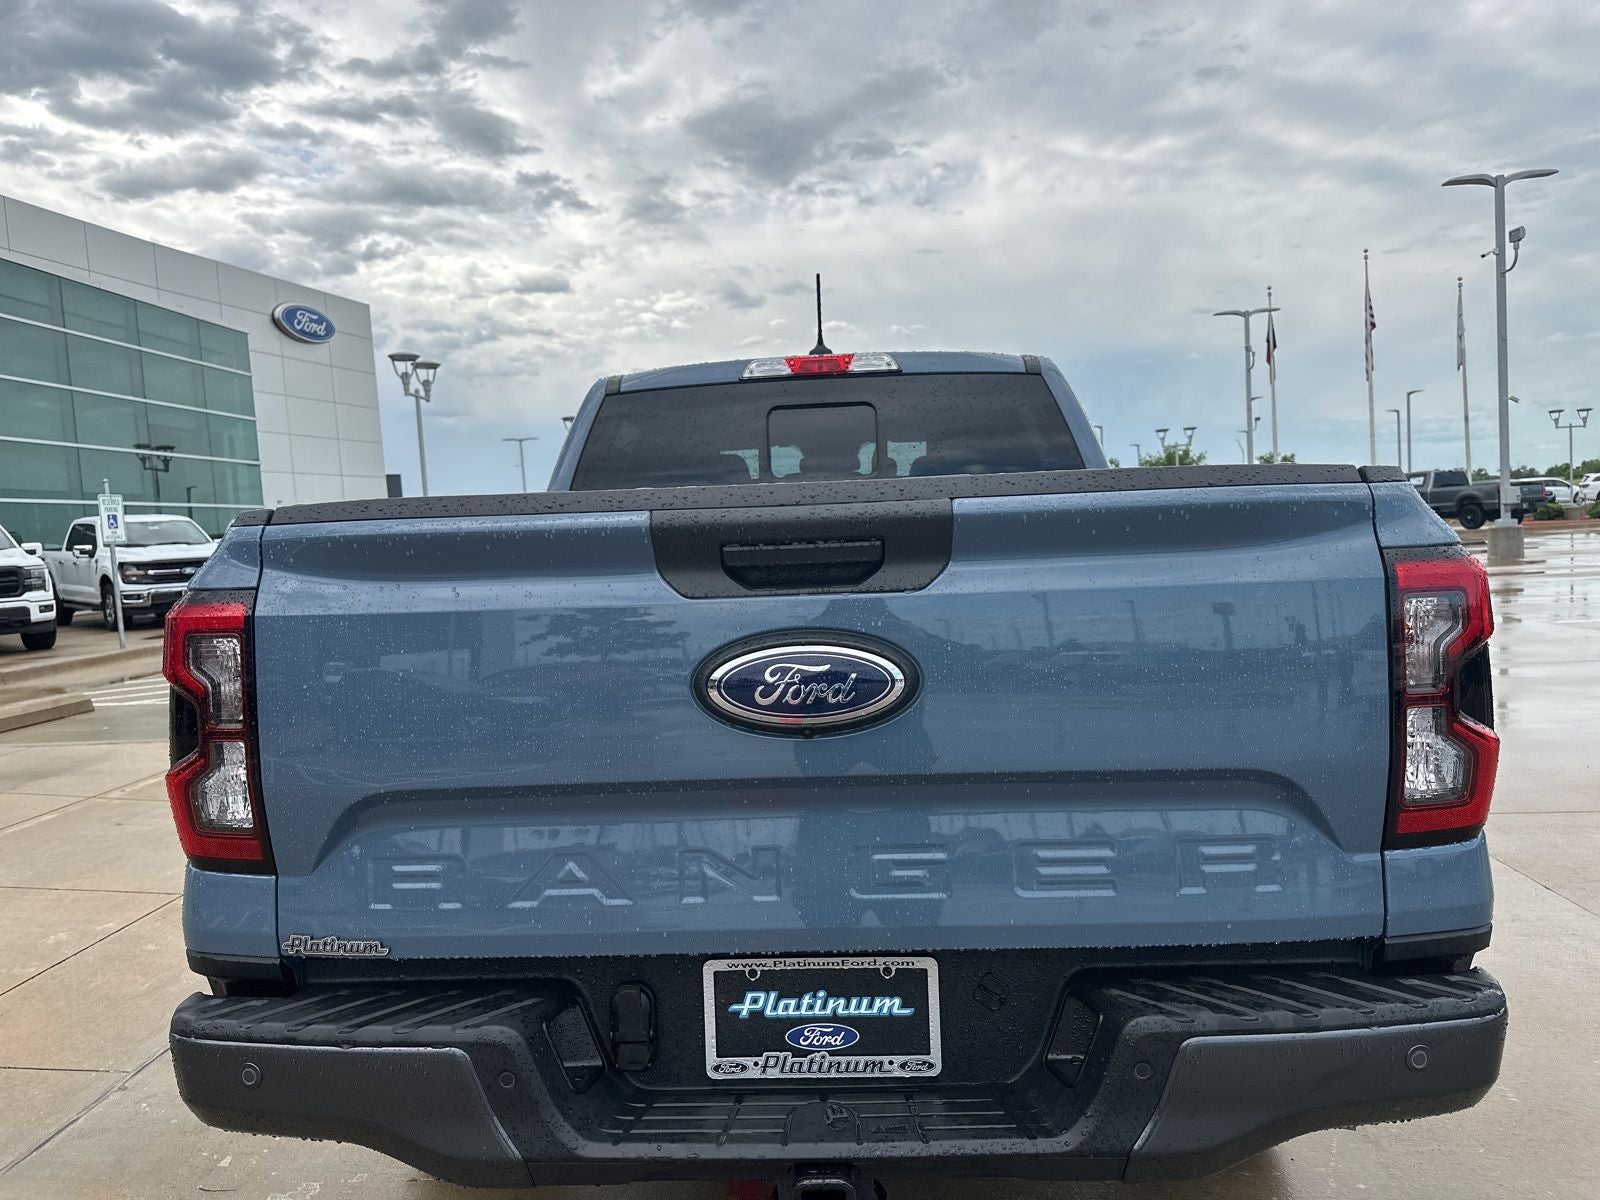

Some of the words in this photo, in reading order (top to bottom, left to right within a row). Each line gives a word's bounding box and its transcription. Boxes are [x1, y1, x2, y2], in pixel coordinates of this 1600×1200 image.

[294, 310, 327, 336] Ford
[754, 663, 858, 706] Ford
[369, 836, 1284, 910] RANGER
[281, 935, 390, 956] Platinum
[727, 959, 915, 969] www.PlatinumFord.com
[729, 990, 915, 1019] Platinum
[799, 1026, 845, 1046] Ford
[717, 1062, 743, 1073] Ford
[760, 1052, 895, 1075] Platinum
[904, 1061, 930, 1071] Ford
